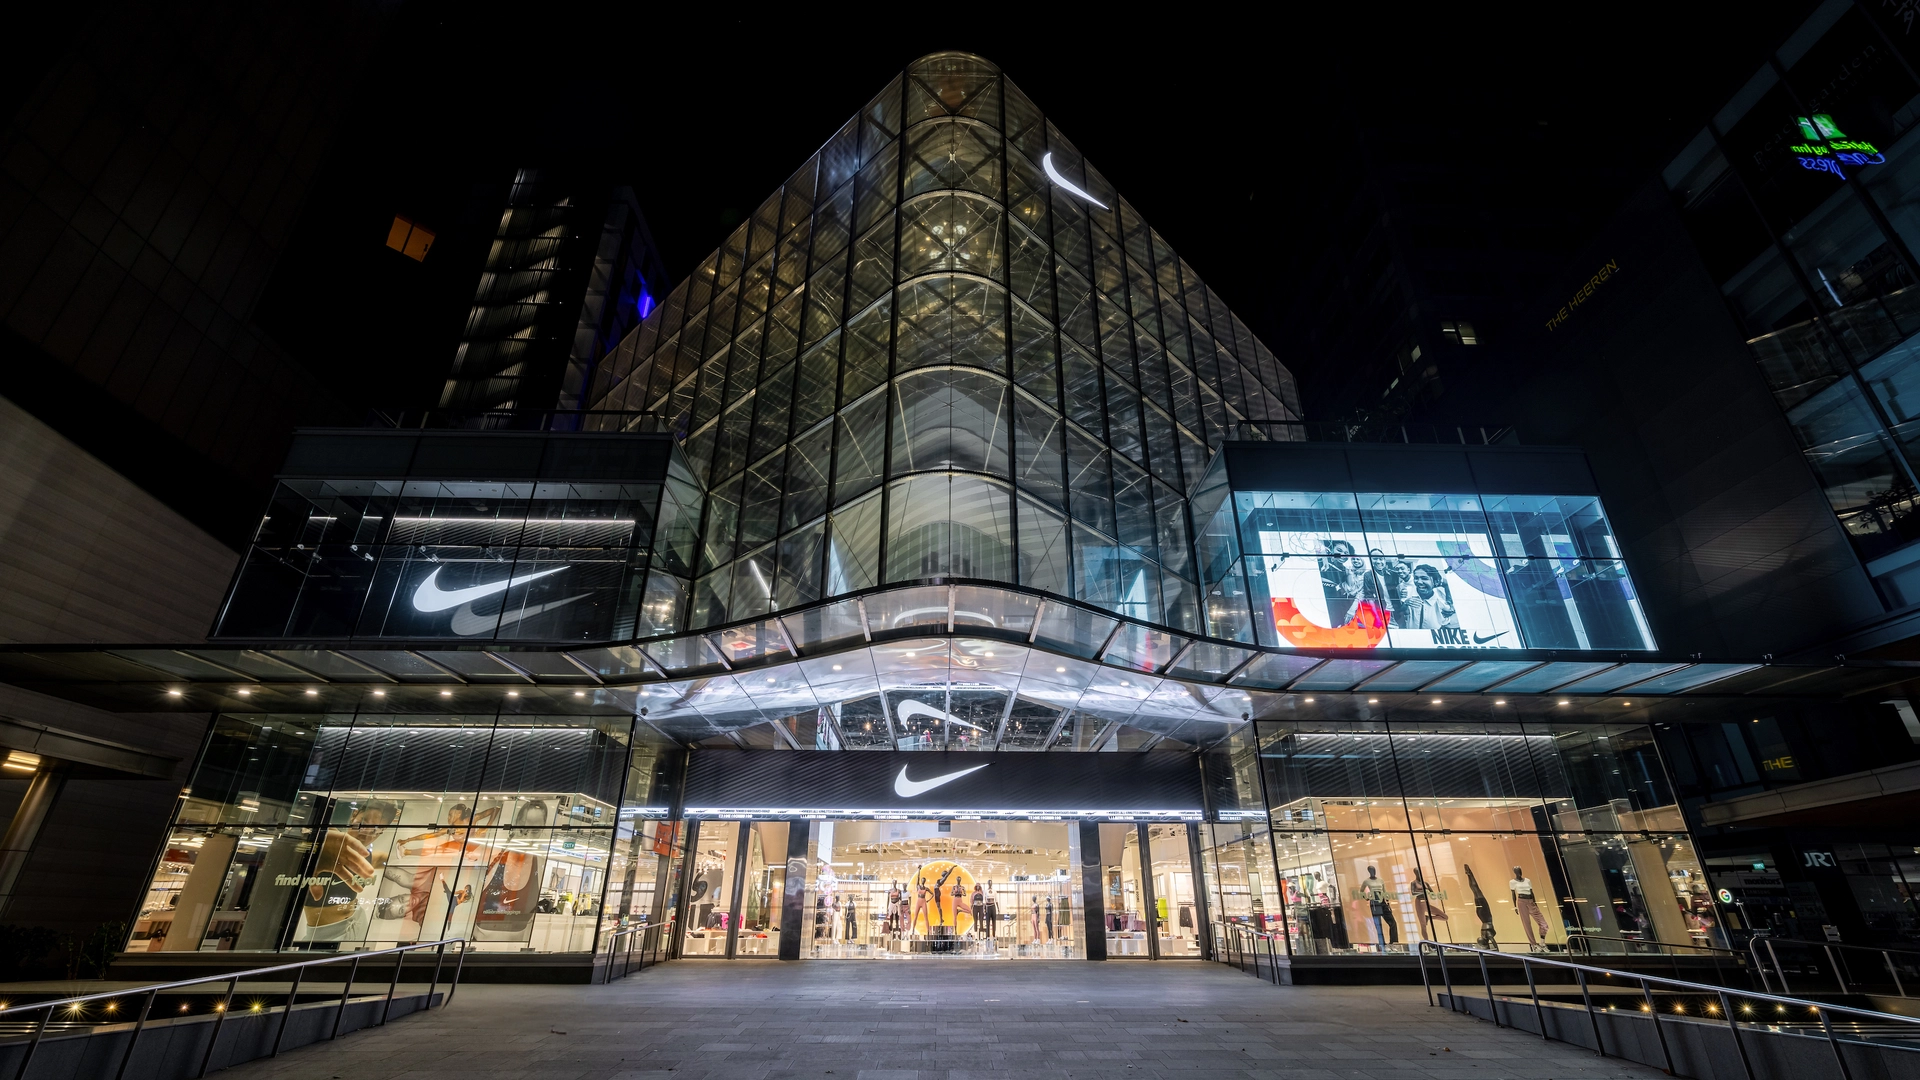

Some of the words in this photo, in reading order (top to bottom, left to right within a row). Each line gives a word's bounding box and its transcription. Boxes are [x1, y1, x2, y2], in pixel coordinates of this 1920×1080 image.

[1545, 306, 1569, 332] THE
[1568, 258, 1618, 311] HEEREN
[1431, 628, 1470, 645] NIKE
[1762, 756, 1794, 771] THE
[274, 874, 301, 886] find
[302, 875, 332, 889] your
[1744, 877, 1780, 885] monitors
